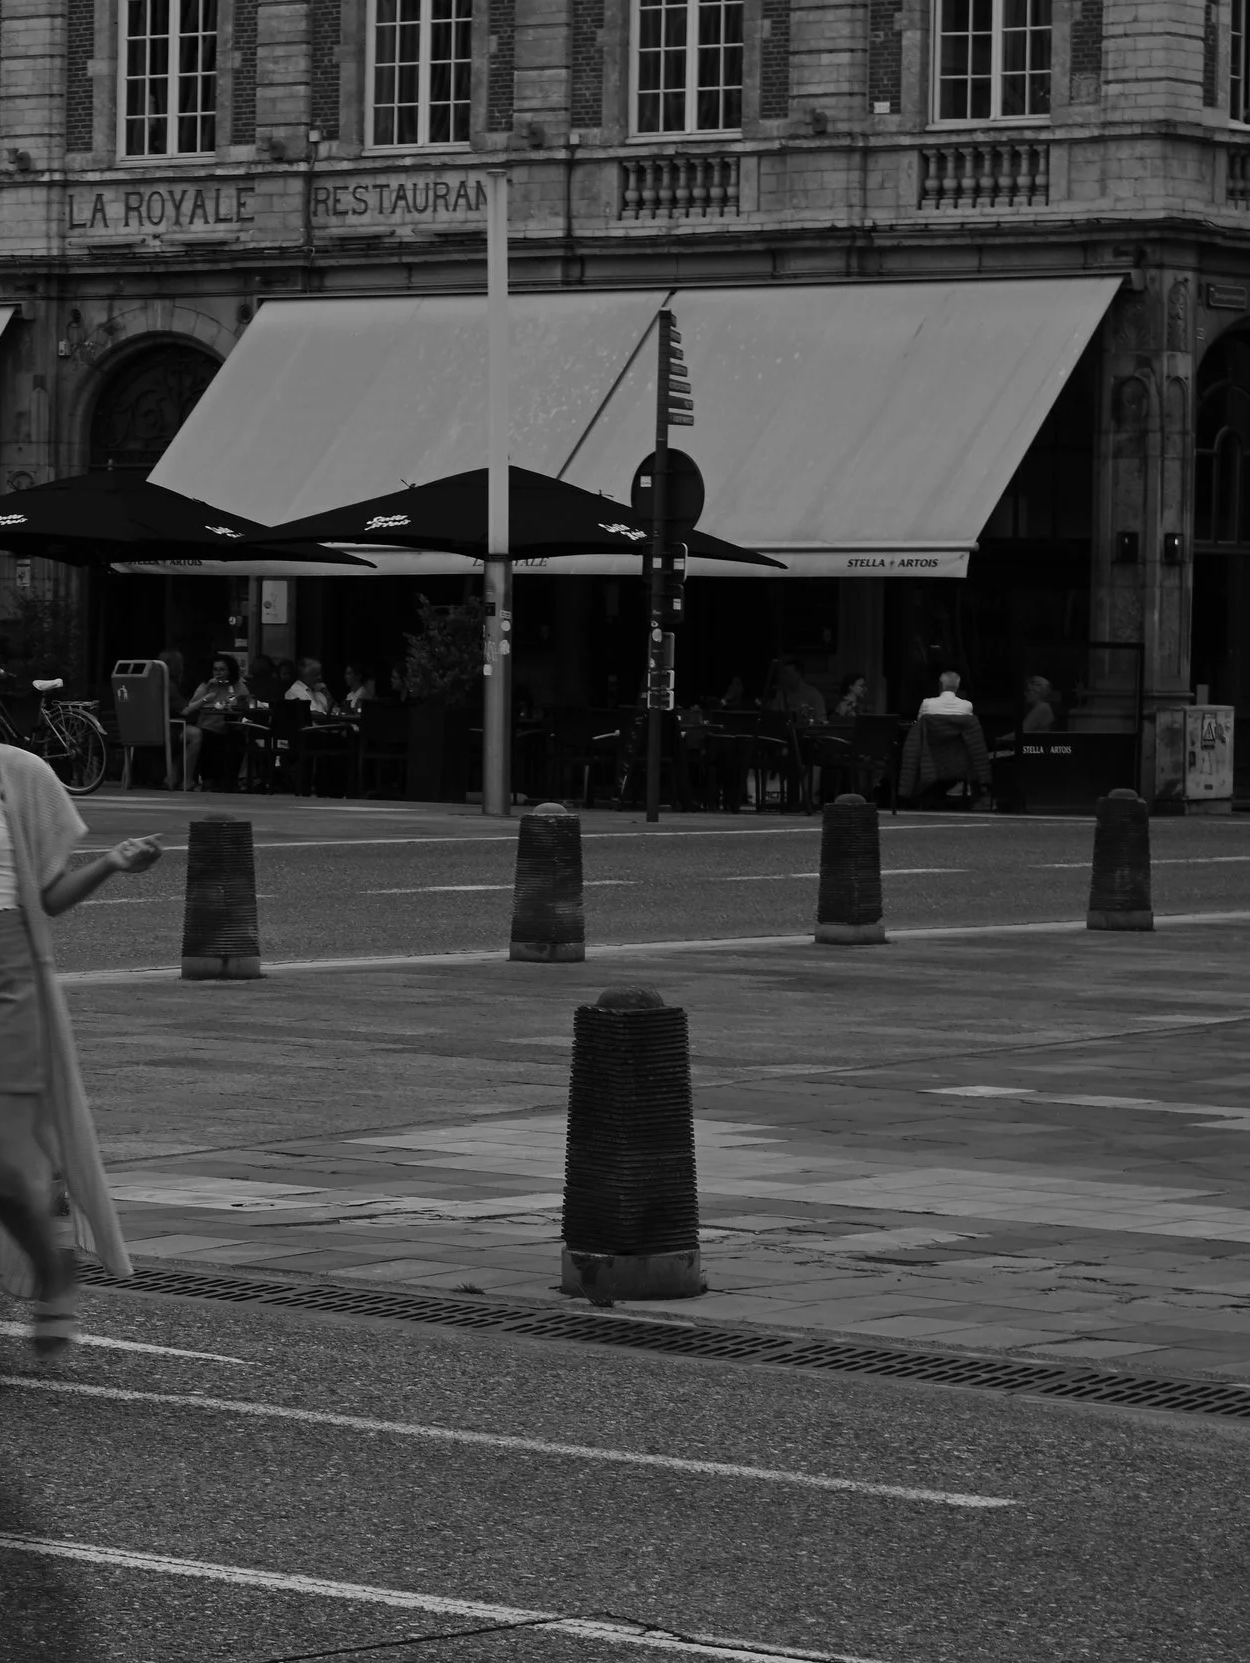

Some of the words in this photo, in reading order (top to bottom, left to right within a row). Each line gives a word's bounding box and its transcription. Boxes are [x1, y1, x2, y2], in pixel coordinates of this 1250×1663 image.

[68, 193, 109, 229] LA
[123, 186, 255, 227] ROYALE
[312, 180, 488, 217] RESTAURAN
[847, 558, 885, 568] STELLA
[897, 558, 938, 568] ARTOIS
[1022, 745, 1045, 755] STELLA
[1050, 745, 1072, 755] ARTOIS
